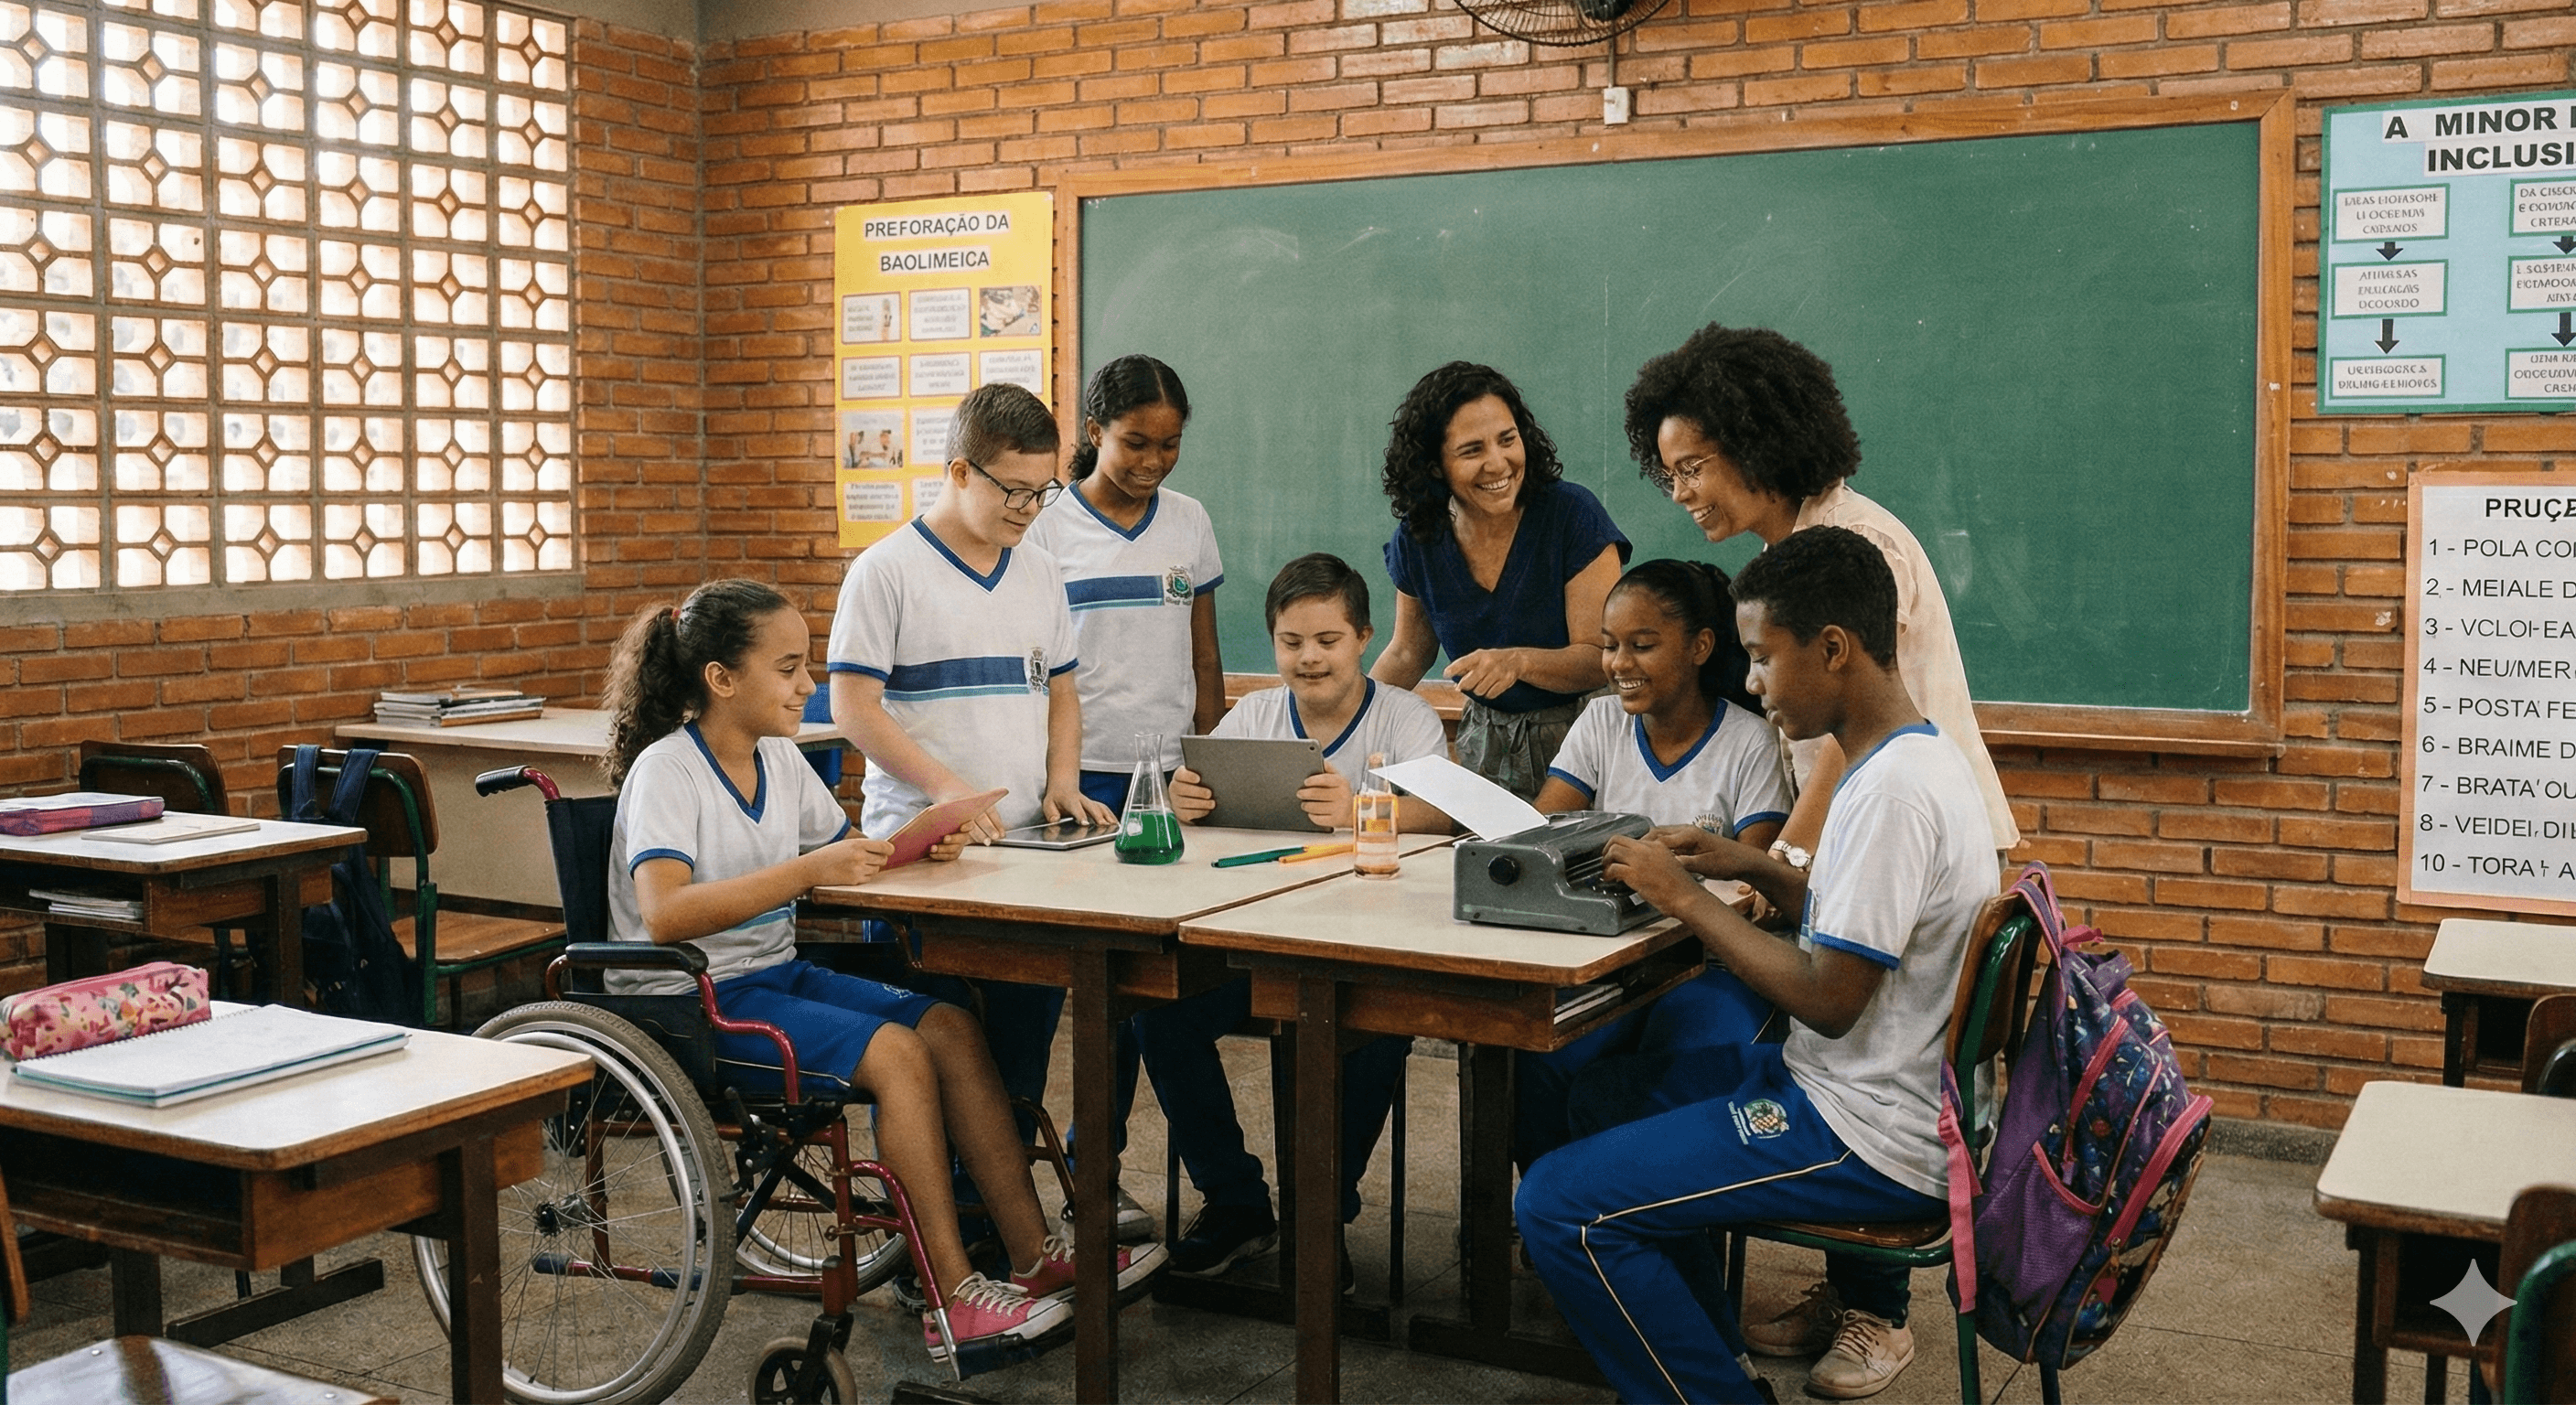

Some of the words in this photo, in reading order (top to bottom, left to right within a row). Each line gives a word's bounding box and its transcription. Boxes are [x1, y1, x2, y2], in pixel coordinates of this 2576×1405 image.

[2384, 116, 2409, 139] A
[2435, 106, 2558, 136] MINOR
[2428, 141, 2576, 172] INCLUSI
[864, 213, 980, 238] PREFORAÇÃO
[986, 214, 1009, 230] DA
[881, 251, 990, 272] BAOLIMEICA
[2429, 538, 2437, 556] 1
[2463, 539, 2528, 557] POLA
[2535, 540, 2576, 558] CO
[2463, 579, 2553, 598] MEIALE
[2425, 617, 2438, 636] 3
[2423, 657, 2437, 674] 4
[2460, 659, 2576, 680] NEU/MER
[2423, 696, 2436, 713] 5
[2422, 735, 2435, 753] 6
[2458, 737, 2551, 758] BRAIME
[2422, 775, 2433, 792] 7
[2420, 813, 2433, 831] 8
[2420, 853, 2445, 872] 10
[2467, 856, 2535, 877] TORA
